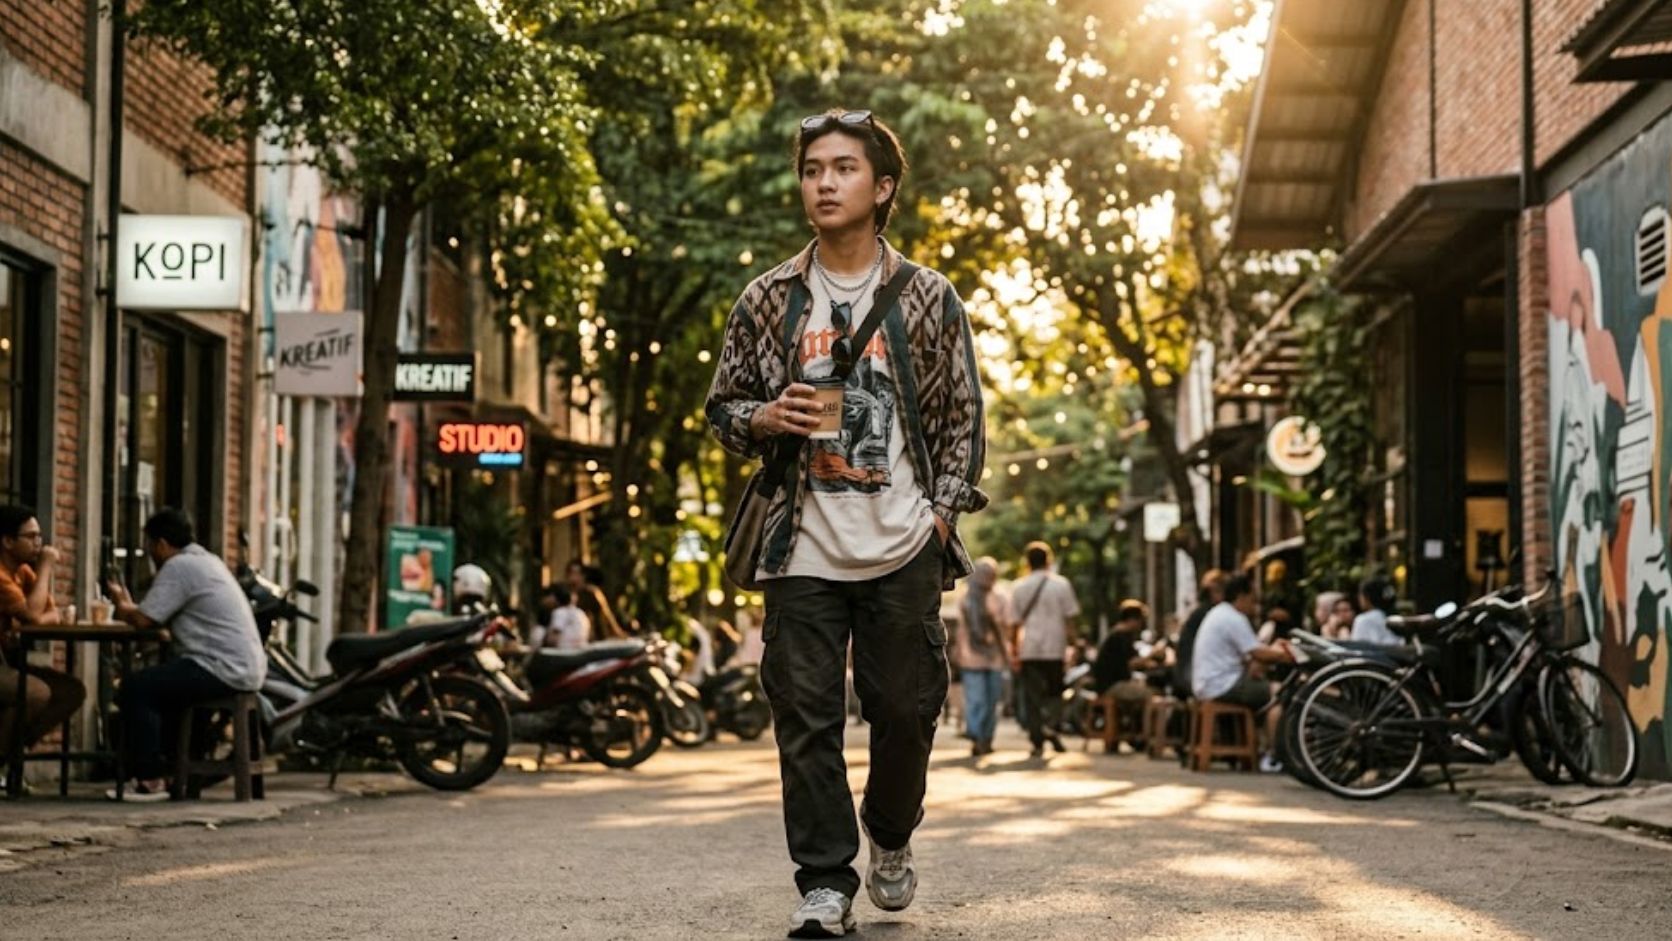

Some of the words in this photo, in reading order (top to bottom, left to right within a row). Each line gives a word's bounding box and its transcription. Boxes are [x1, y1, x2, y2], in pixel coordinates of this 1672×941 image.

[134, 242, 225, 280] KOPI
[280, 333, 355, 368] KREATIF
[395, 363, 472, 392] KREATIF
[439, 423, 524, 453] STUDIO
